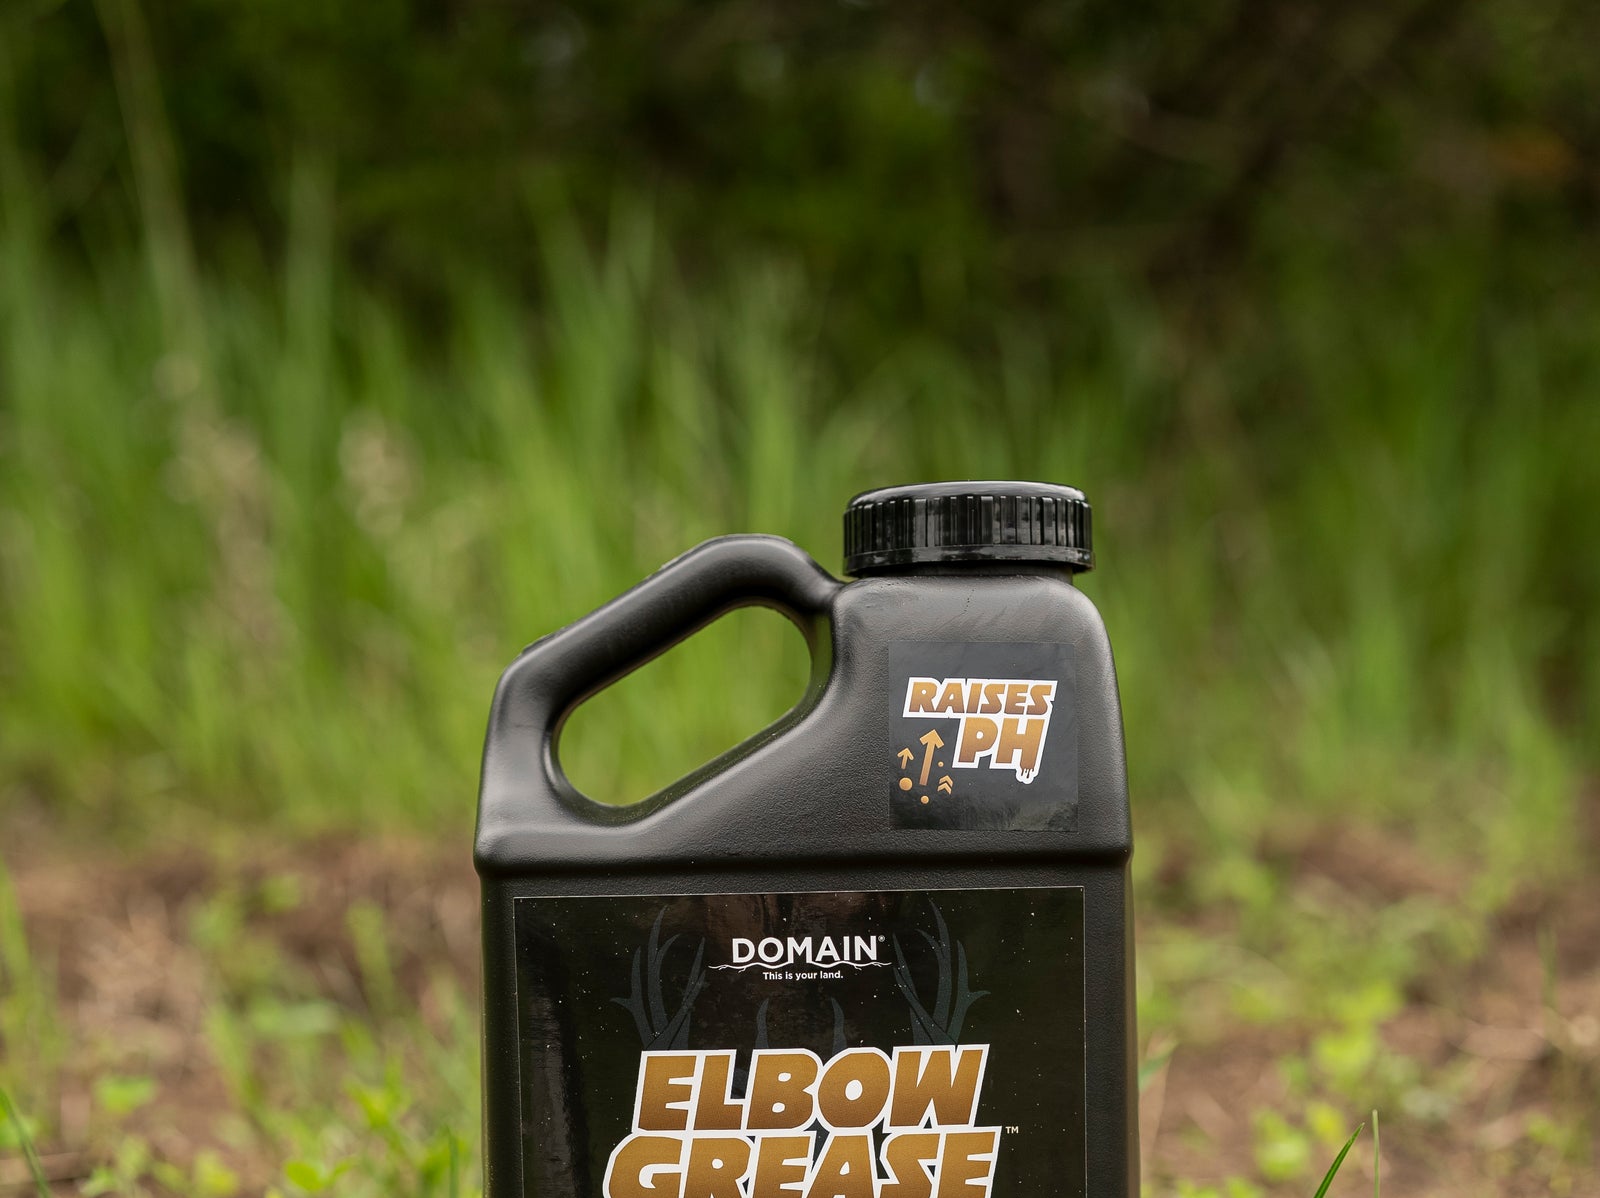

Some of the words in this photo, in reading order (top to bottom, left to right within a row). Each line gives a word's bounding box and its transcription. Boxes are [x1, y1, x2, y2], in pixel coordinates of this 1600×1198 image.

[904, 678, 1056, 718] RAISES
[953, 717, 1047, 784] PH
[763, 972, 783, 980] This
[785, 971, 793, 980] is
[795, 972, 818, 981] your
[820, 970, 843, 979] land.
[632, 1044, 990, 1134] ELBOW
